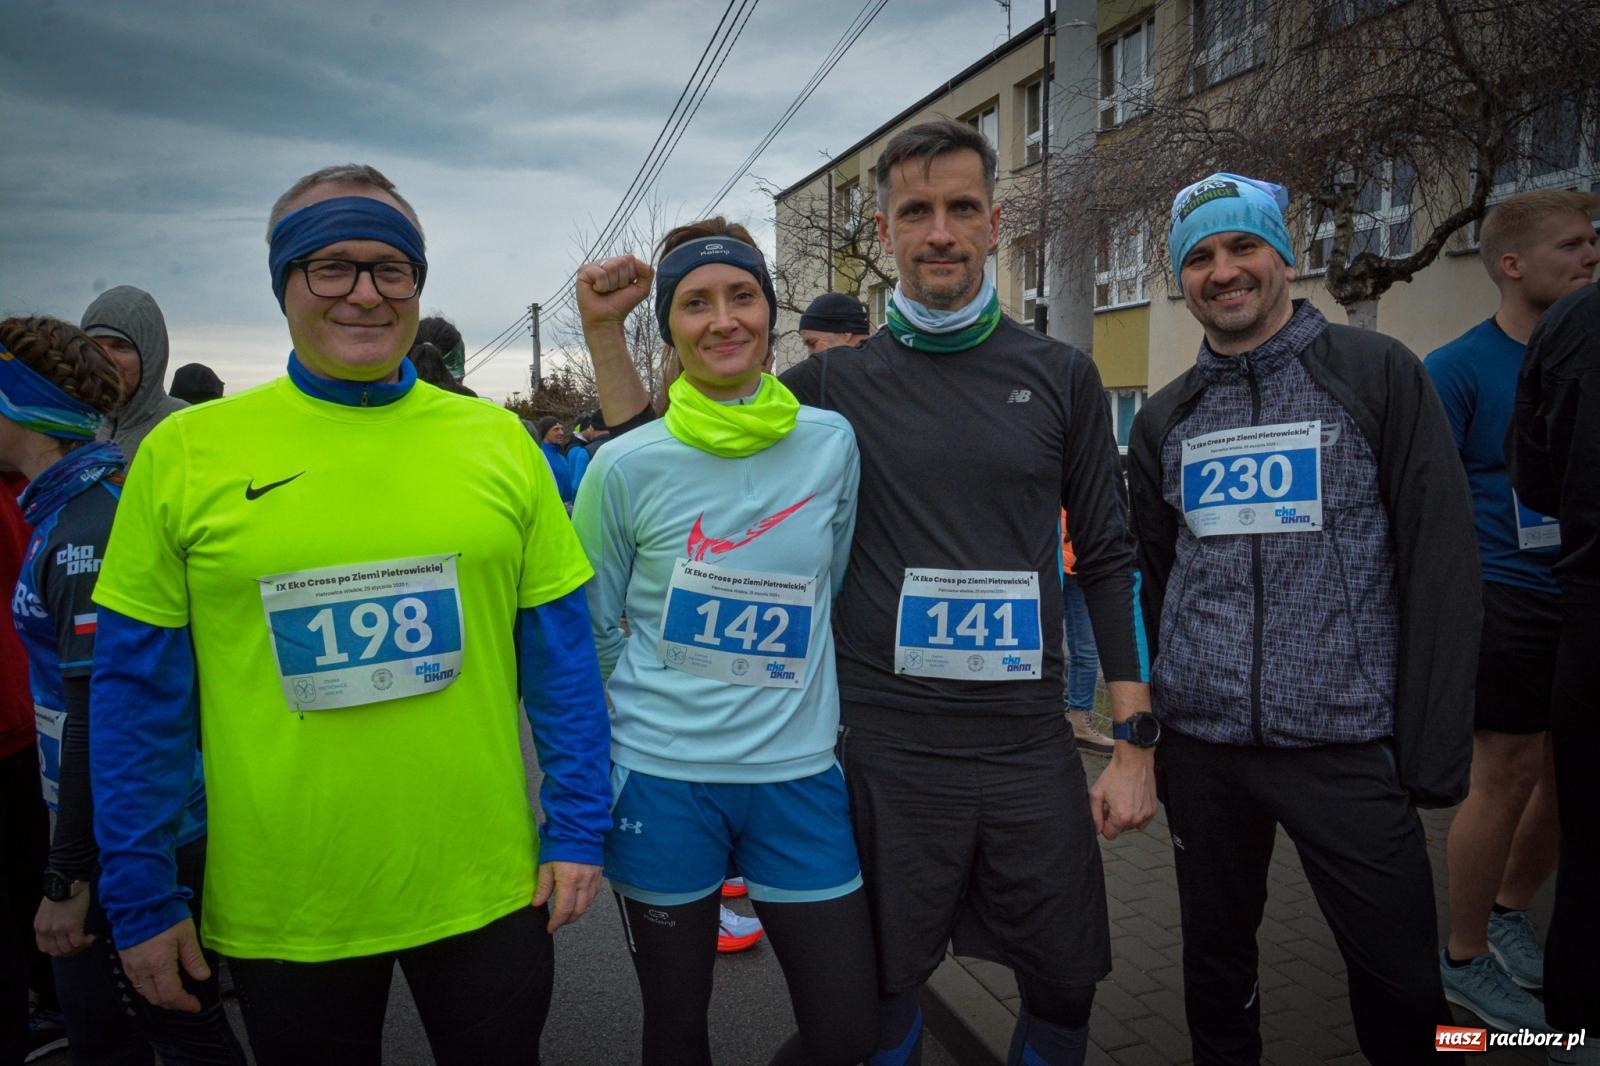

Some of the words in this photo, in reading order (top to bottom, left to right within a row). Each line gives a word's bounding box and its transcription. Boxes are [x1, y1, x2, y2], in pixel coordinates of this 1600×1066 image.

[1207, 438, 1225, 446] Cross
[1226, 436, 1235, 444] po
[1237, 432, 1257, 441] Ziemi
[1259, 428, 1310, 439] Pietrowickiej
[1199, 454, 1293, 504] 230
[276, 582, 287, 592] IX
[288, 580, 306, 590] Eko
[307, 576, 337, 587] Cross
[338, 575, 351, 585] po
[351, 570, 380, 581] Ziemi
[381, 563, 443, 578] Pietrowickiej
[684, 567, 692, 575] IX
[693, 569, 707, 578] Eko
[709, 573, 731, 582] Cross
[732, 578, 742, 586] po
[743, 578, 762, 586] Ziemi
[763, 580, 807, 592] Pietrowickiej
[934, 576, 956, 584] Cross
[957, 578, 967, 586] po
[988, 578, 1030, 587] Pietrowickiej
[12, 581, 48, 618] RS
[307, 597, 433, 666] 198
[694, 600, 789, 653] 142
[926, 601, 1019, 646] 141
